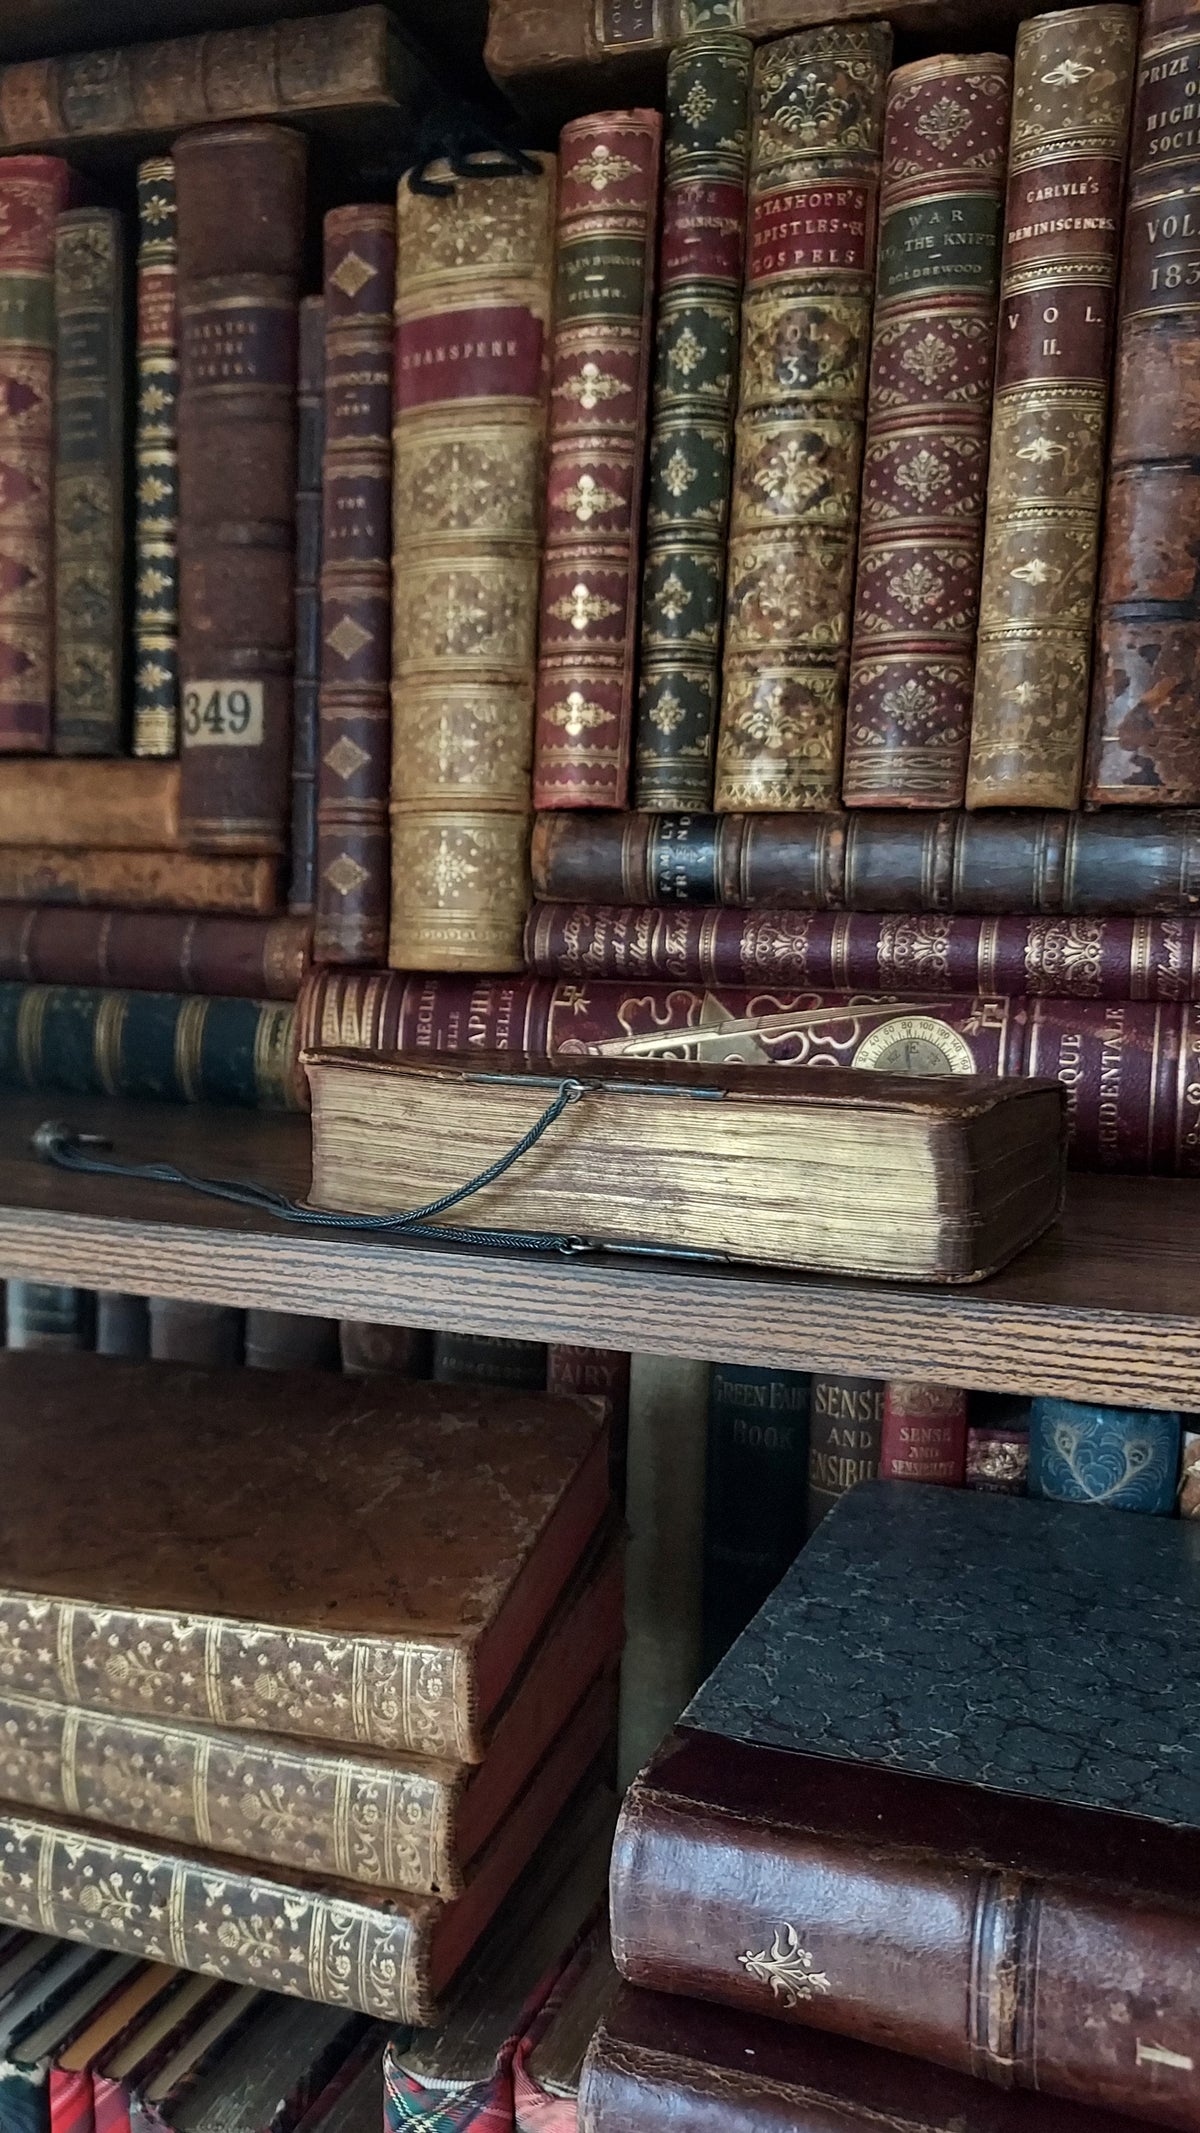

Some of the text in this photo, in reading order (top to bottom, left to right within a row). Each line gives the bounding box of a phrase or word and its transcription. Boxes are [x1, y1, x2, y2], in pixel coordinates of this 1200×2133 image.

[1138, 55, 1191, 87] PRIZE
[1146, 104, 1200, 132] HIGH
[1027, 176, 1099, 203] CARLYLE'S
[755, 192, 863, 220] STANHOPE'S
[908, 209, 964, 227] WAR
[904, 235, 935, 252] THE
[943, 232, 996, 247] KNIFE
[752, 250, 855, 273] GOSPELS
[184, 689, 252, 736] 349
[661, 819, 674, 892] FAMILY
[869, 1035, 880, 1047] 40
[883, 1025, 895, 1036] 60
[901, 1021, 913, 1030] 80
[920, 1021, 935, 1031] 100
[826, 1427, 872, 1448] AND
[900, 1427, 950, 1442] SENSE
